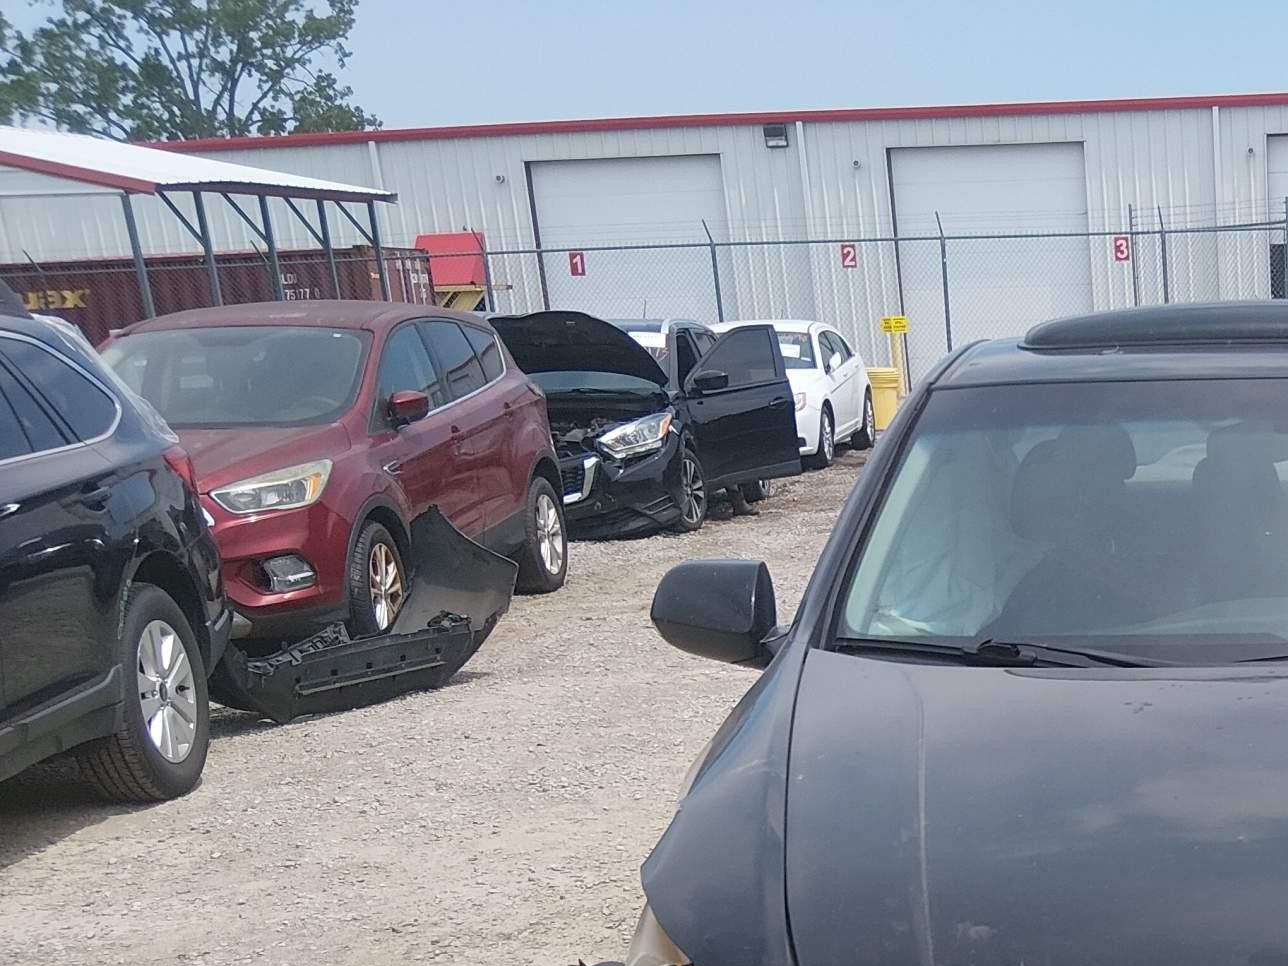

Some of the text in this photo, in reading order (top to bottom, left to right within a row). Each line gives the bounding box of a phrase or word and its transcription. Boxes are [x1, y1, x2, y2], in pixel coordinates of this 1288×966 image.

[843, 247, 856, 266] 2
[1116, 239, 1129, 259] 3
[572, 254, 583, 274] 1
